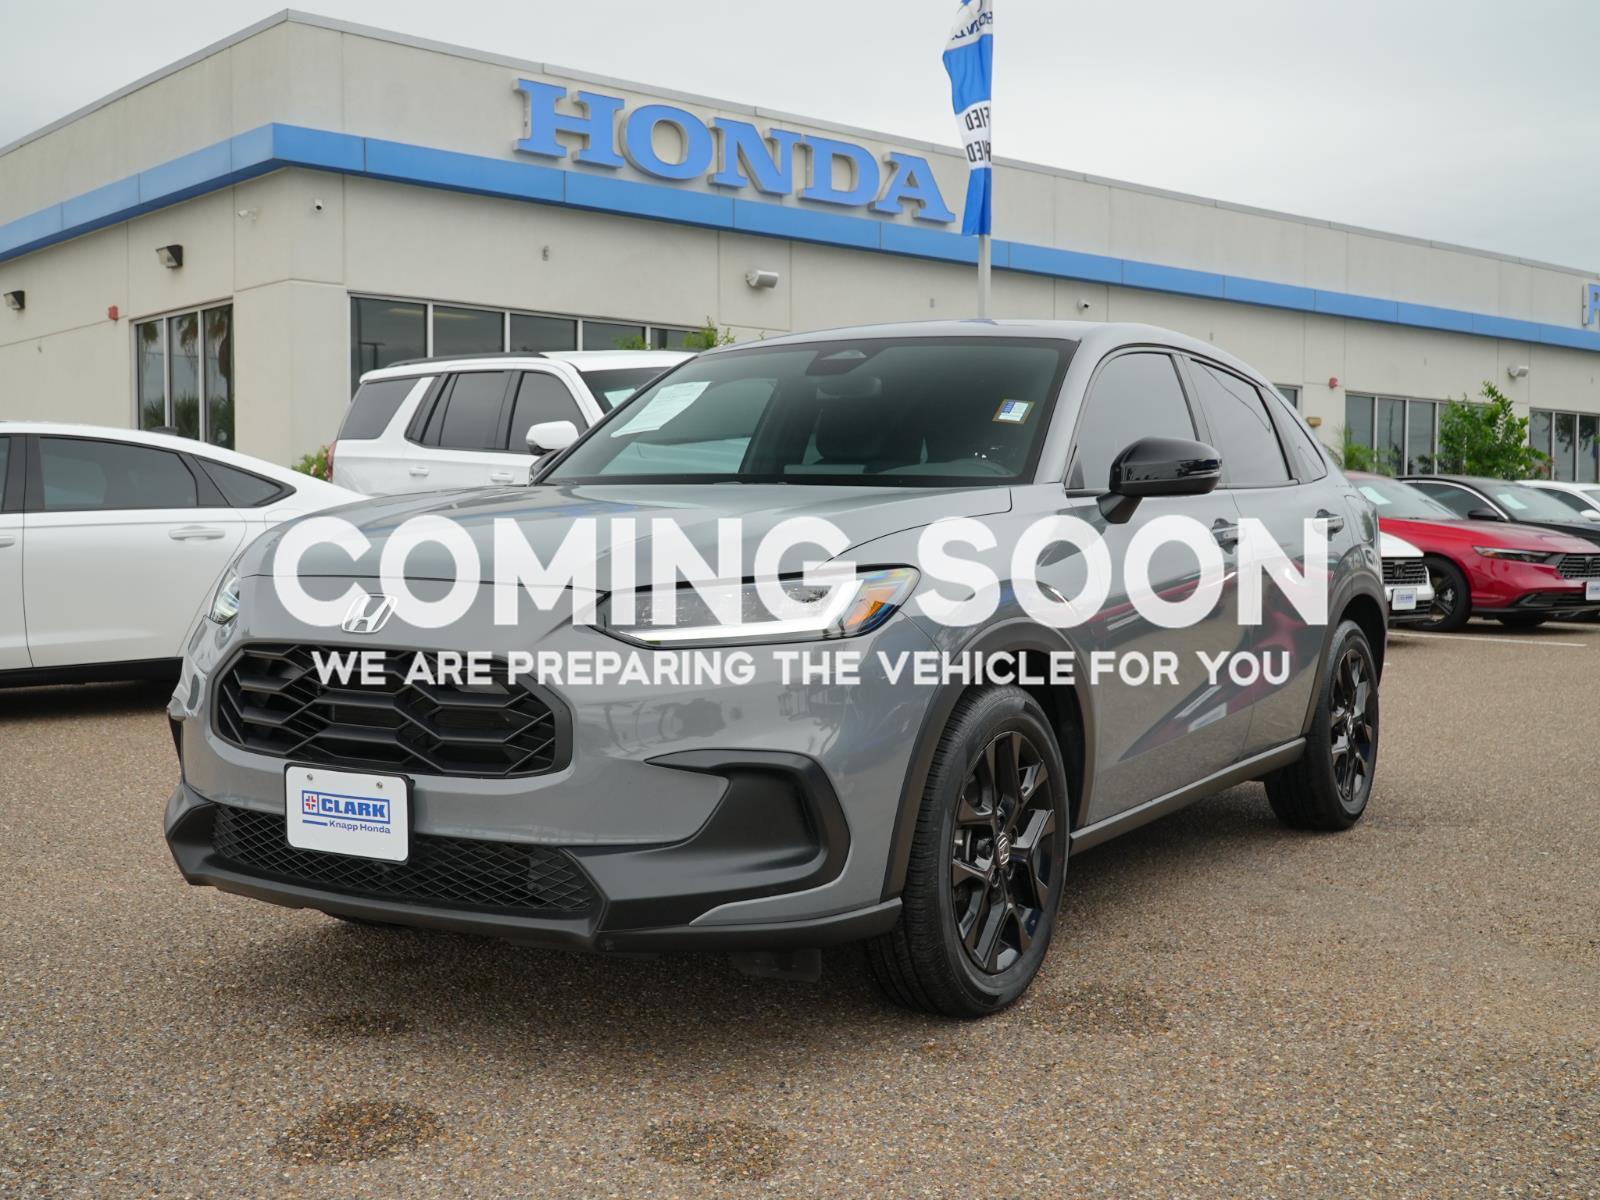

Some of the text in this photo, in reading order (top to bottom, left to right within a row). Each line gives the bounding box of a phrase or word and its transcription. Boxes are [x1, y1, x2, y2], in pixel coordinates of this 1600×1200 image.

[513, 78, 956, 223] HONDA
[321, 798, 386, 818] CLARK
[329, 820, 391, 834] Knapp Honda
